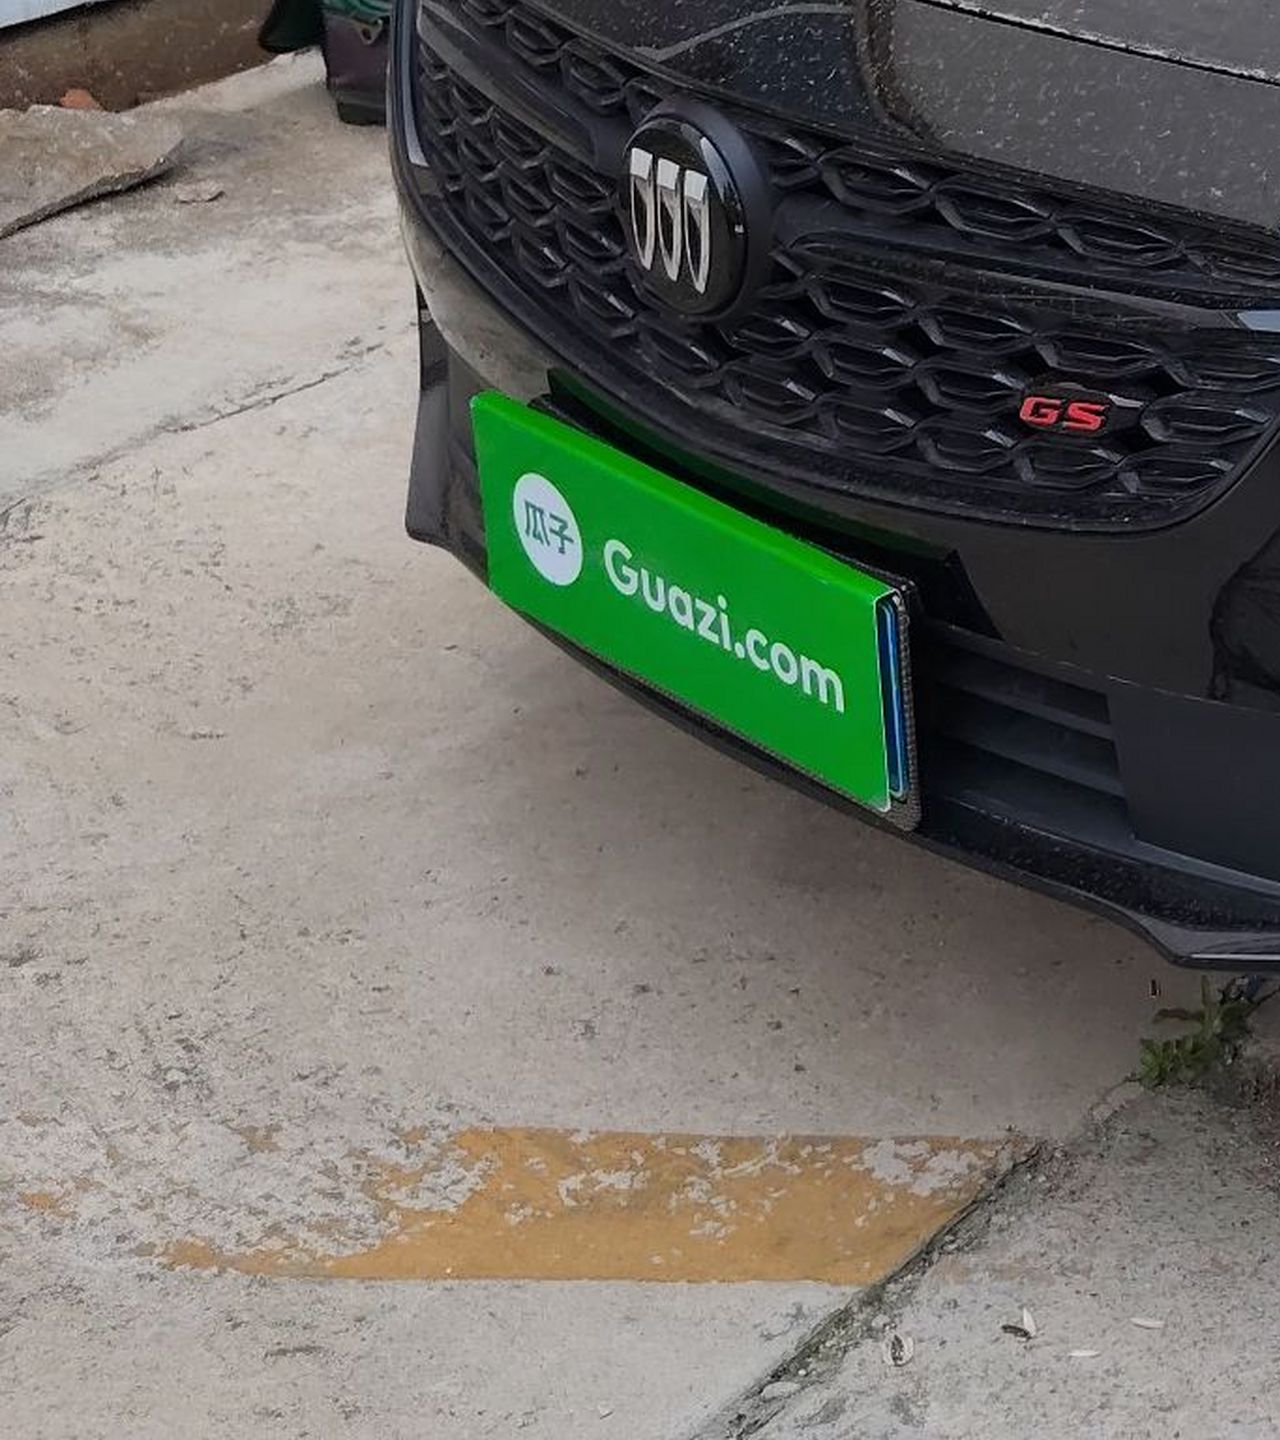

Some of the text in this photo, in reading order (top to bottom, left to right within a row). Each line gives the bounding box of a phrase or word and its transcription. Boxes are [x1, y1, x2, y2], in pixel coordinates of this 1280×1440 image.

[1019, 396, 1106, 431] GS
[524, 500, 574, 554] 瓜子
[603, 539, 845, 713] Guazi.com
